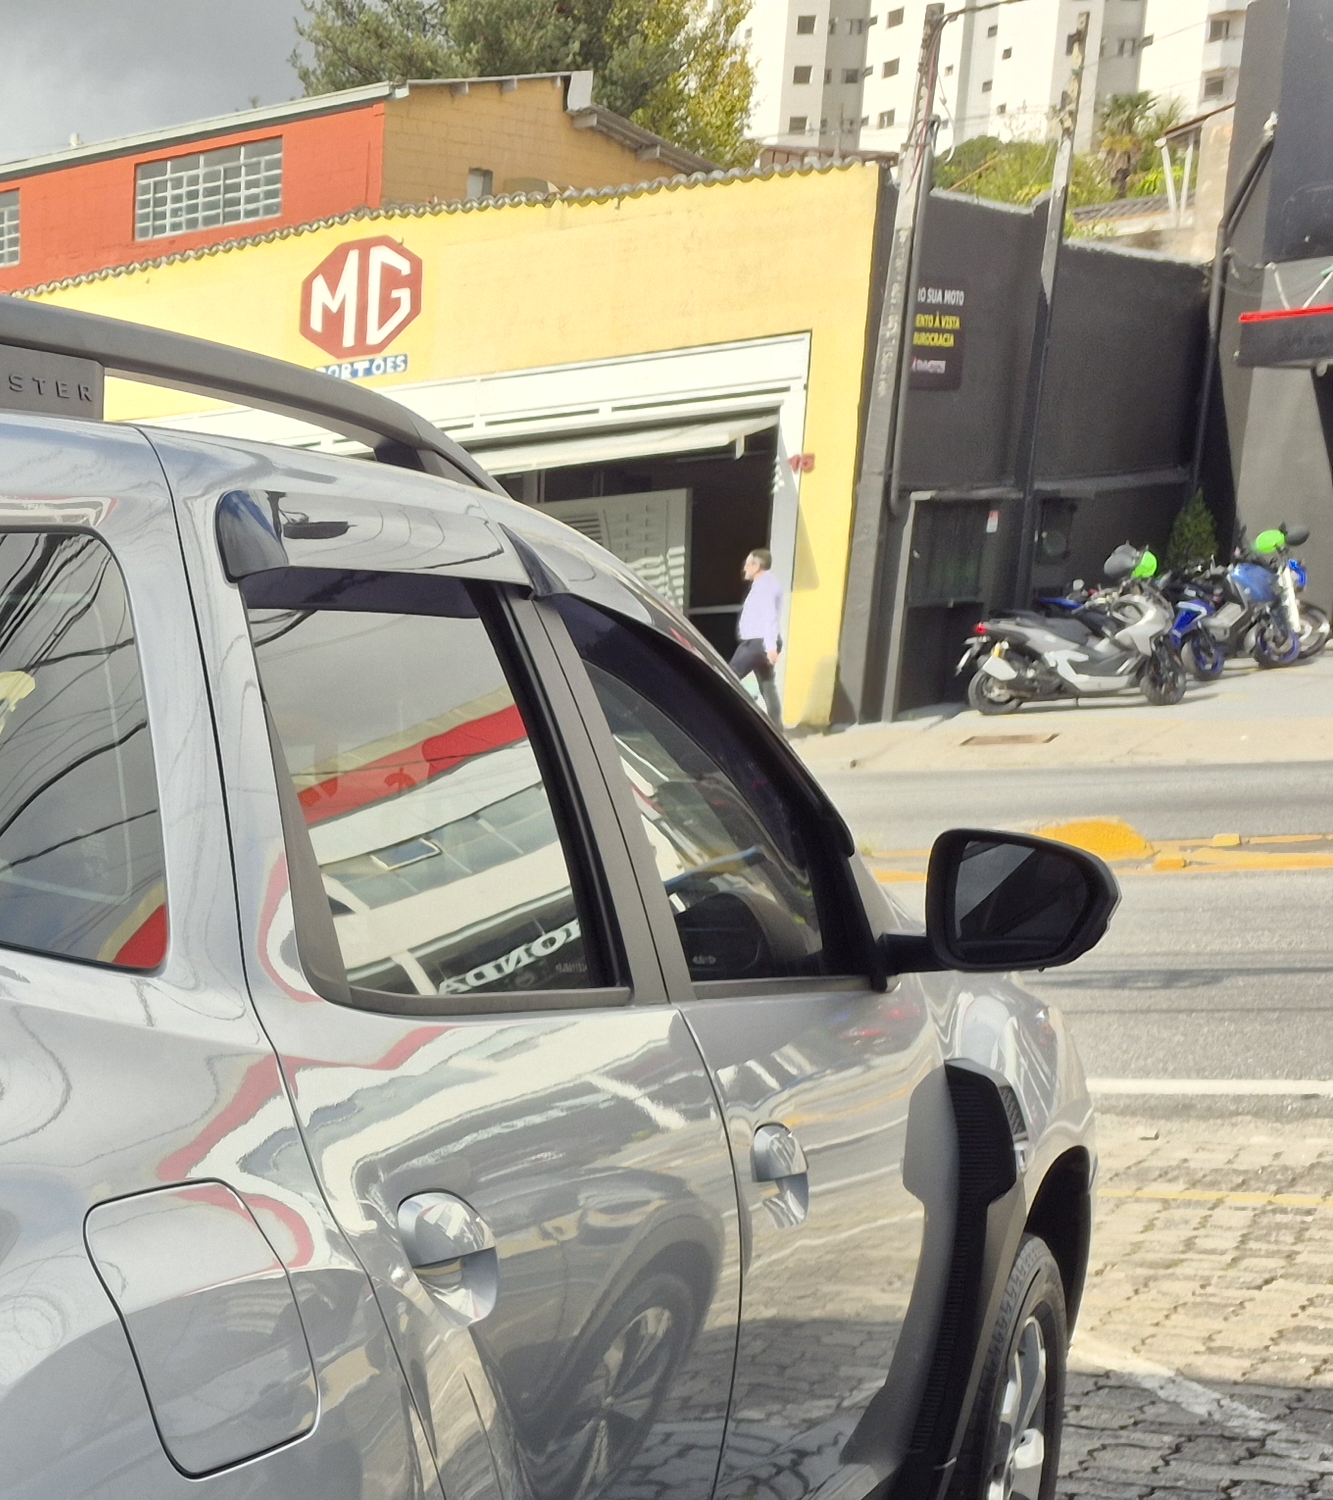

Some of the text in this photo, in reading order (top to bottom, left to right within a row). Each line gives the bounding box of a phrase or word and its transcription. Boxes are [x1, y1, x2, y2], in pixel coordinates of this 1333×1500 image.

[309, 244, 412, 348] MG
[927, 288, 942, 304] SUA
[943, 289, 965, 306] MOTO
[941, 315, 961, 330] VISTA
